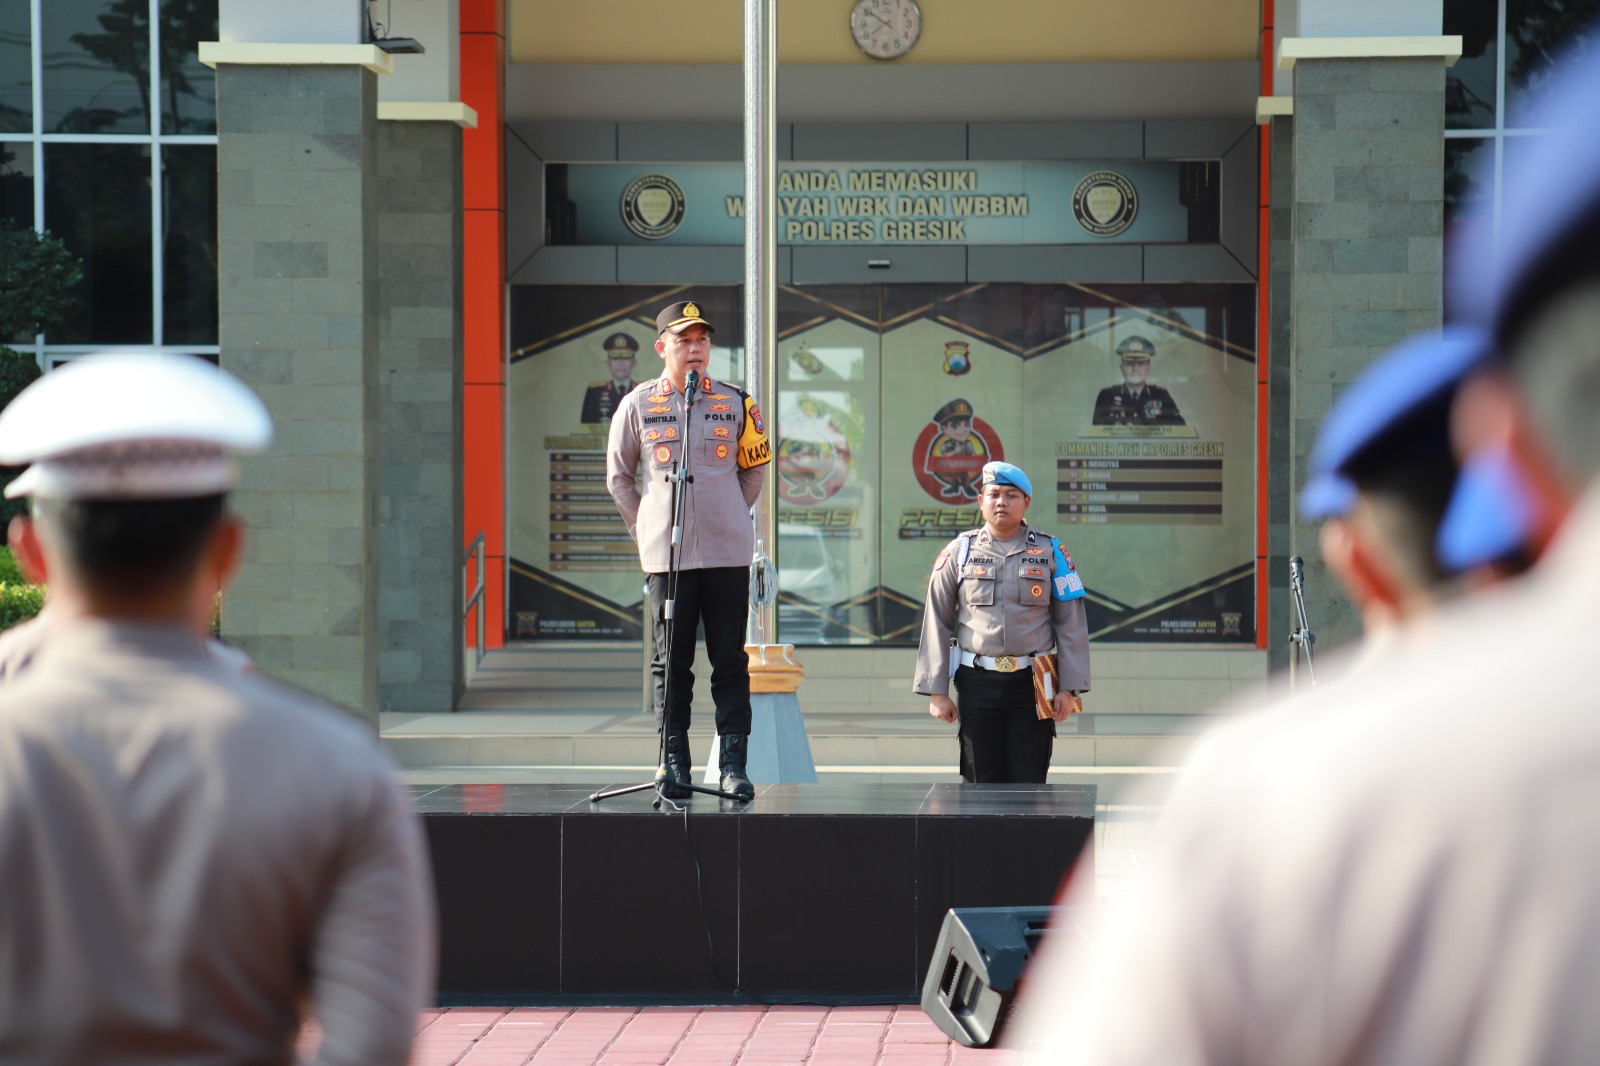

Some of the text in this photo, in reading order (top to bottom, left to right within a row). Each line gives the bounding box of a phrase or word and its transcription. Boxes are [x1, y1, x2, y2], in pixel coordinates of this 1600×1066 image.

[779, 171, 977, 191] ANDA MEMASUKI
[726, 195, 1028, 217] WYAH WBK DAN WBBM
[786, 220, 966, 241] POLRES GRESIK
[705, 413, 736, 422] POLRI
[1056, 442, 1224, 456] COMMANDER WISH KAPOLRES GRESIK
[778, 508, 859, 527] RESISI
[900, 508, 985, 527] PRESI
[1021, 557, 1049, 565] POLRI
